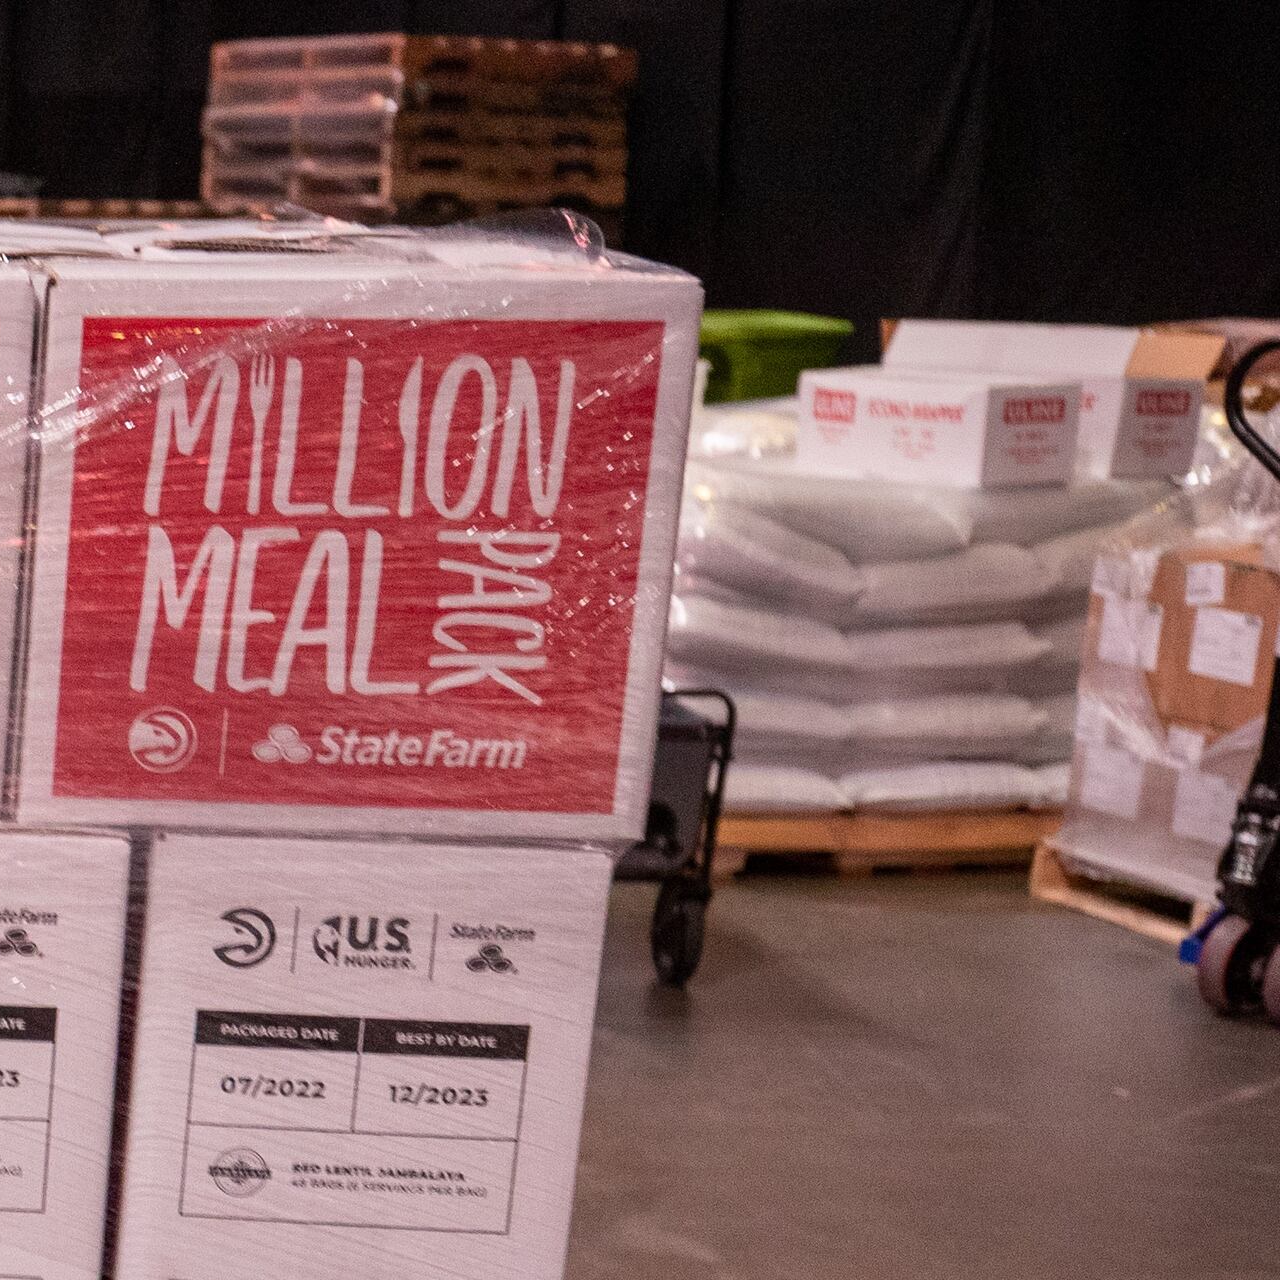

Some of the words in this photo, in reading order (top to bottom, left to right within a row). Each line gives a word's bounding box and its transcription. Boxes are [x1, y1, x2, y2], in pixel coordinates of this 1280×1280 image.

[143, 352, 578, 521] MILLION
[128, 524, 422, 698] MEAL
[426, 529, 564, 708] PACK
[301, 1027, 340, 1042] DATE
[394, 1031, 434, 1046] BEST
[435, 1033, 457, 1047] BY
[457, 1034, 499, 1050] DATE
[220, 1072, 327, 1101] 07/2022
[386, 1081, 490, 1109] 12/2023
